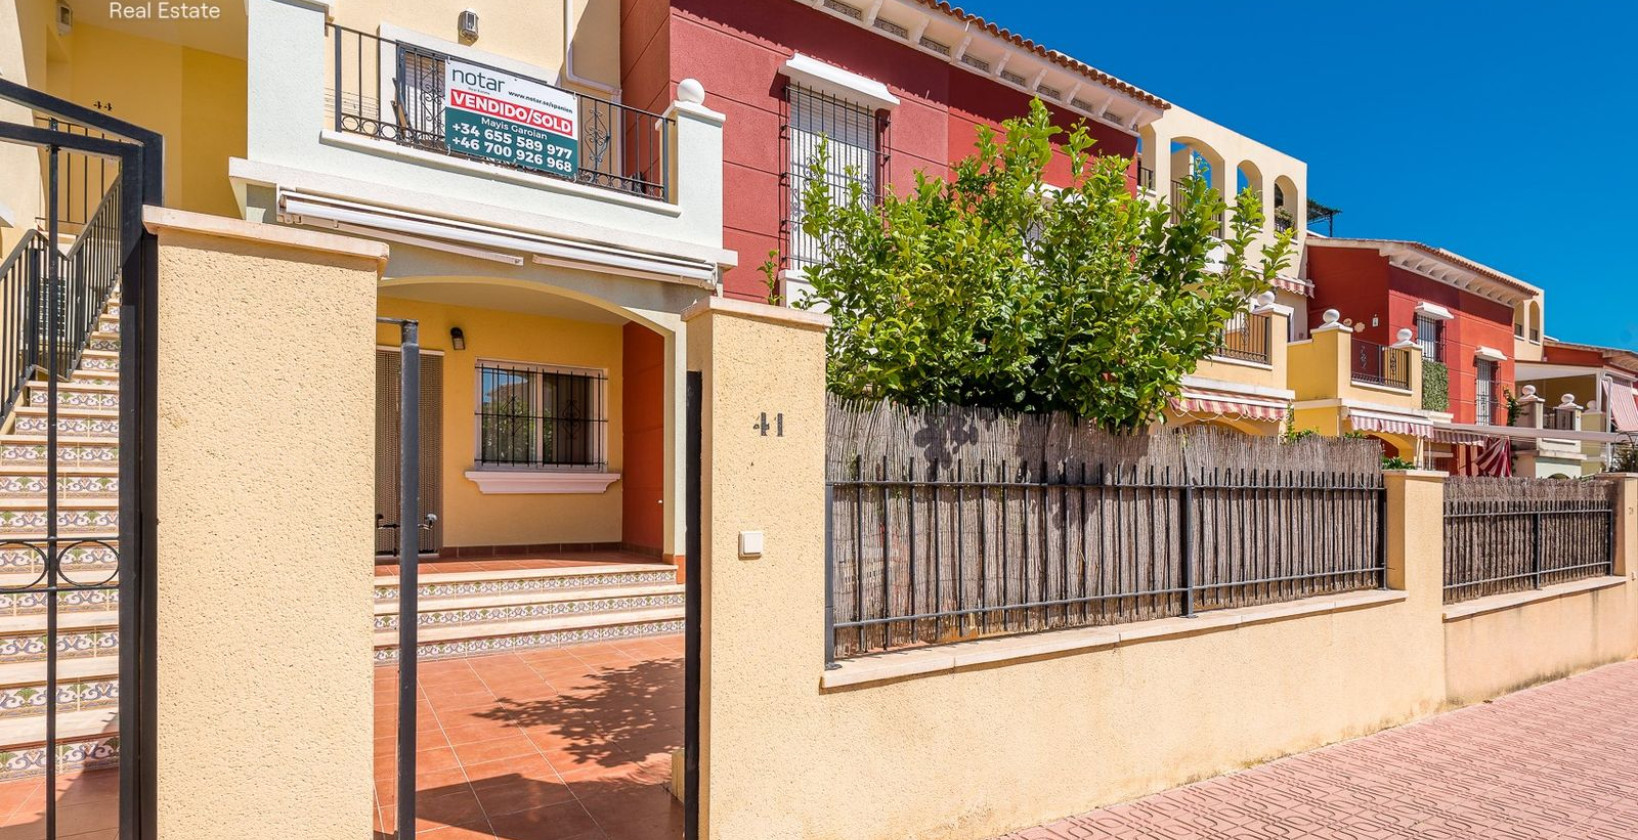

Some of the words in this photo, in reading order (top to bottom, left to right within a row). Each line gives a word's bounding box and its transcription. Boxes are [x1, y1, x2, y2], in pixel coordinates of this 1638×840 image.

[452, 69, 505, 93] notar
[453, 92, 571, 132] VENDIDO/SOLD
[481, 117, 509, 131] Mayis
[452, 122, 480, 138] +34
[484, 129, 512, 144] 655
[516, 136, 543, 152] 589
[547, 144, 573, 159] 977
[452, 138, 480, 150] +46
[485, 143, 512, 157] 700
[516, 150, 543, 165] 926
[547, 158, 572, 172] 968
[753, 412, 784, 437] 41
